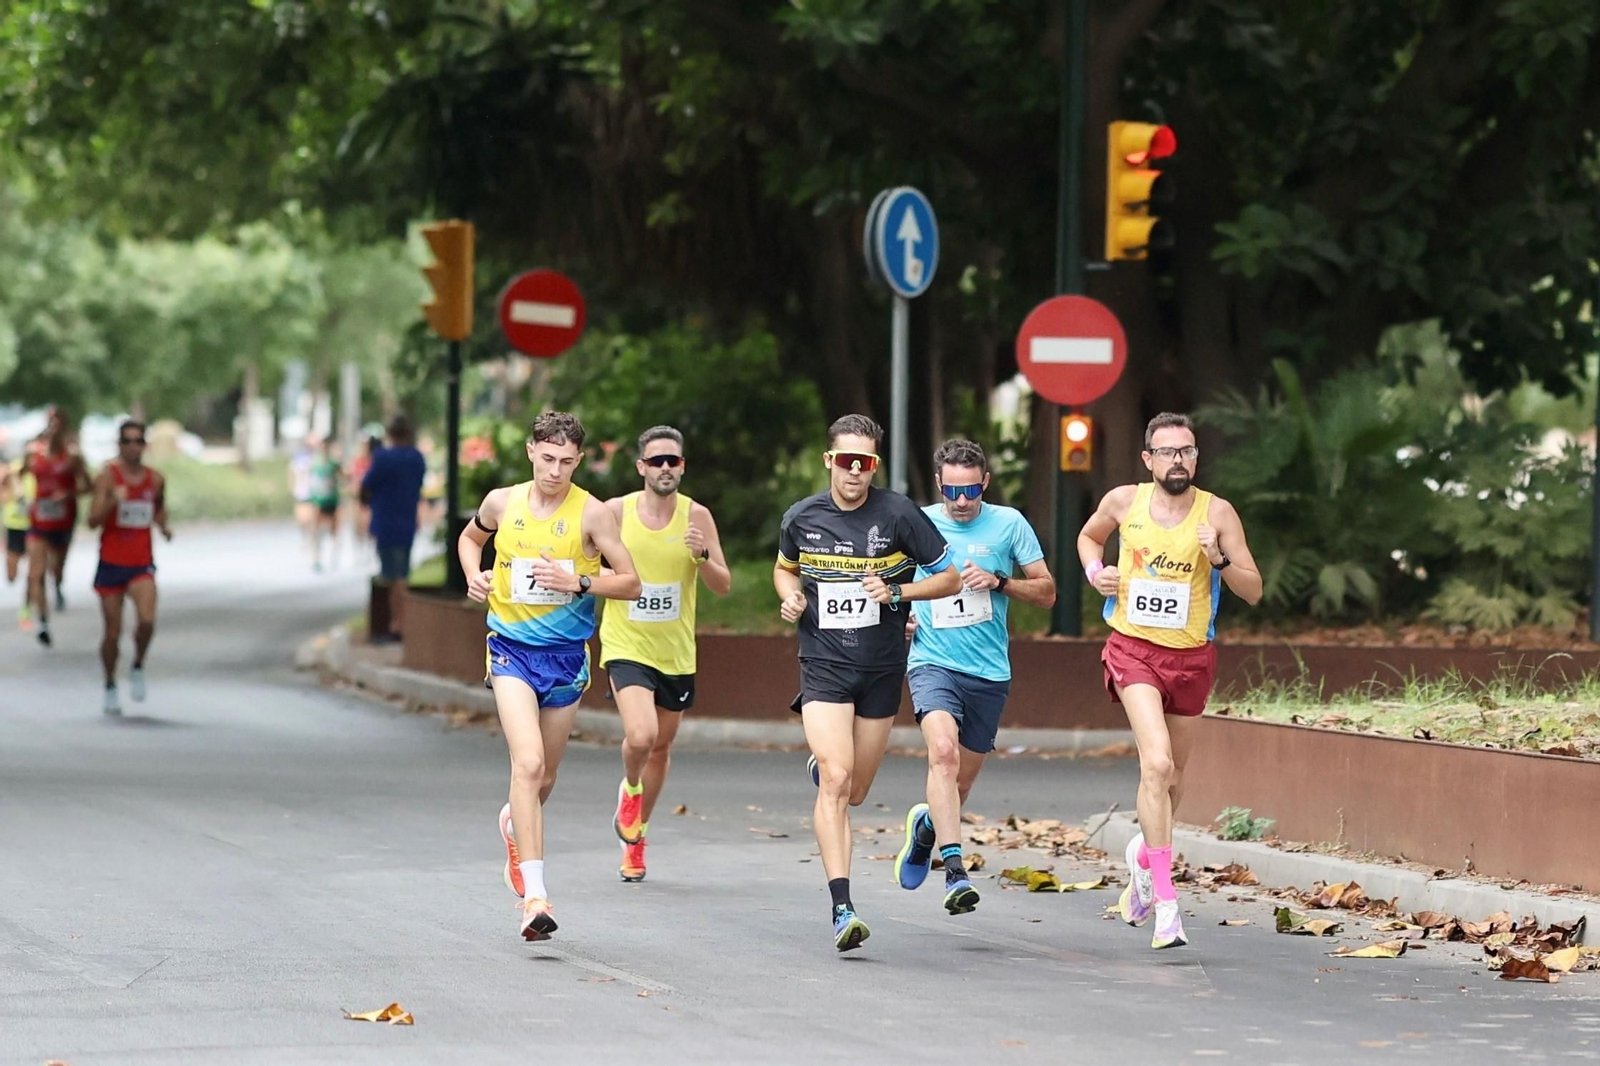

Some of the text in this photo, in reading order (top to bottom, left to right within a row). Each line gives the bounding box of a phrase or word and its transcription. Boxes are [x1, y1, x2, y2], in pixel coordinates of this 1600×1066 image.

[818, 558, 855, 569] TRIATLÓN
[856, 560, 888, 570] MÁLAGA
[1149, 551, 1195, 573] Álora
[636, 596, 673, 610] 885
[827, 597, 867, 615] 847
[953, 598, 965, 613] 1
[1136, 595, 1178, 615] 692
